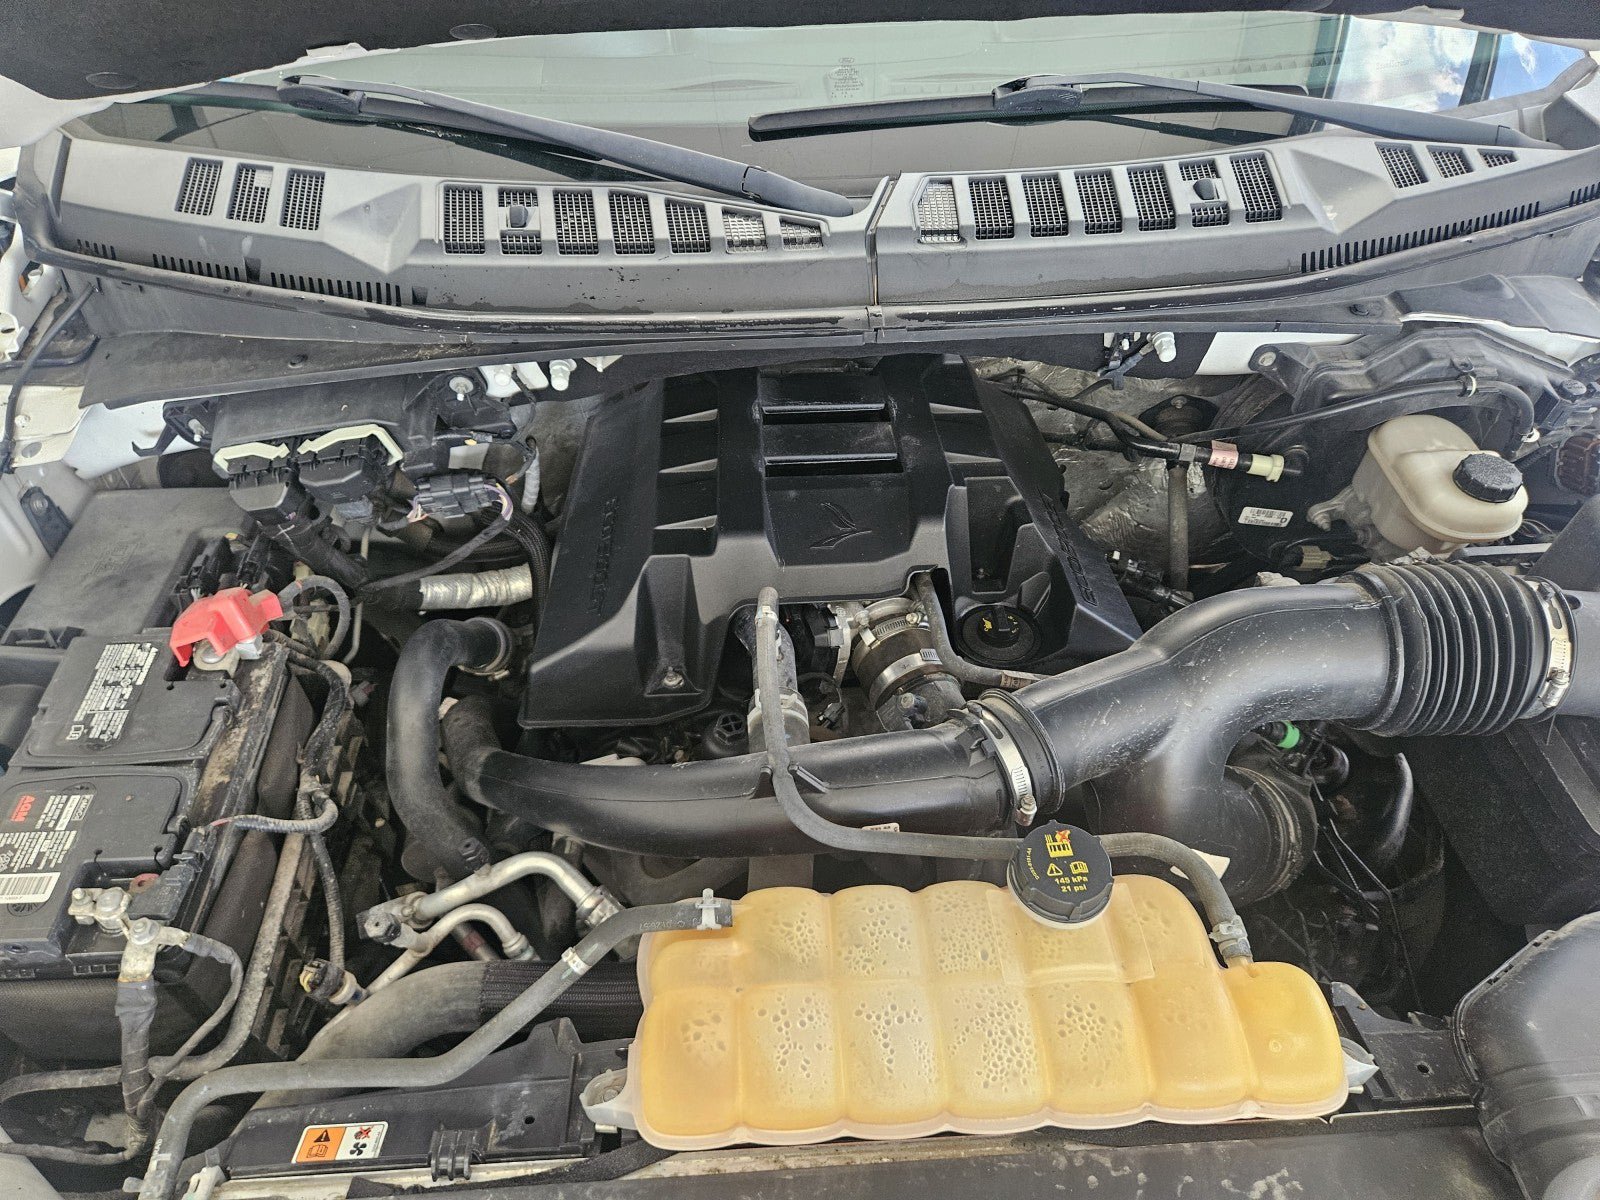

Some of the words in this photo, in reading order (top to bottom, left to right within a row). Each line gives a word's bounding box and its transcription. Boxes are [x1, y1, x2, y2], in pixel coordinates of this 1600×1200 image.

[1055, 877, 1070, 885] 145
[1071, 875, 1089, 883] kPa
[1060, 885, 1072, 893] 21
[1074, 884, 1087, 893] psi
